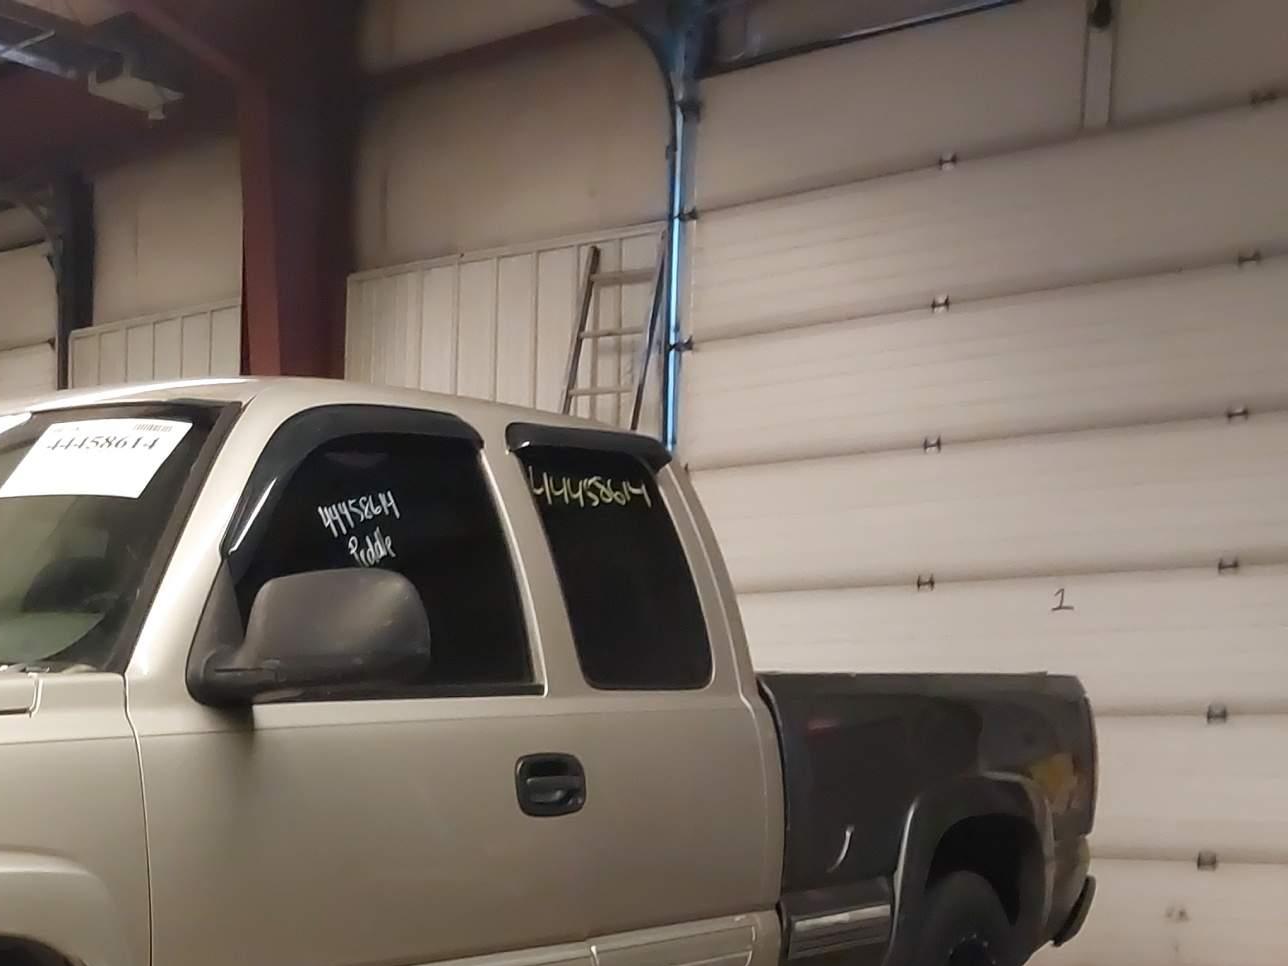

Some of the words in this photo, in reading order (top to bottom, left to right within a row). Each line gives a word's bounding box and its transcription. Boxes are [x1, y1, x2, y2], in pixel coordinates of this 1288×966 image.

[47, 435, 160, 452] 44458614
[529, 465, 652, 508] 44458614
[318, 490, 401, 538] 44458614
[1051, 587, 1075, 612] 1
